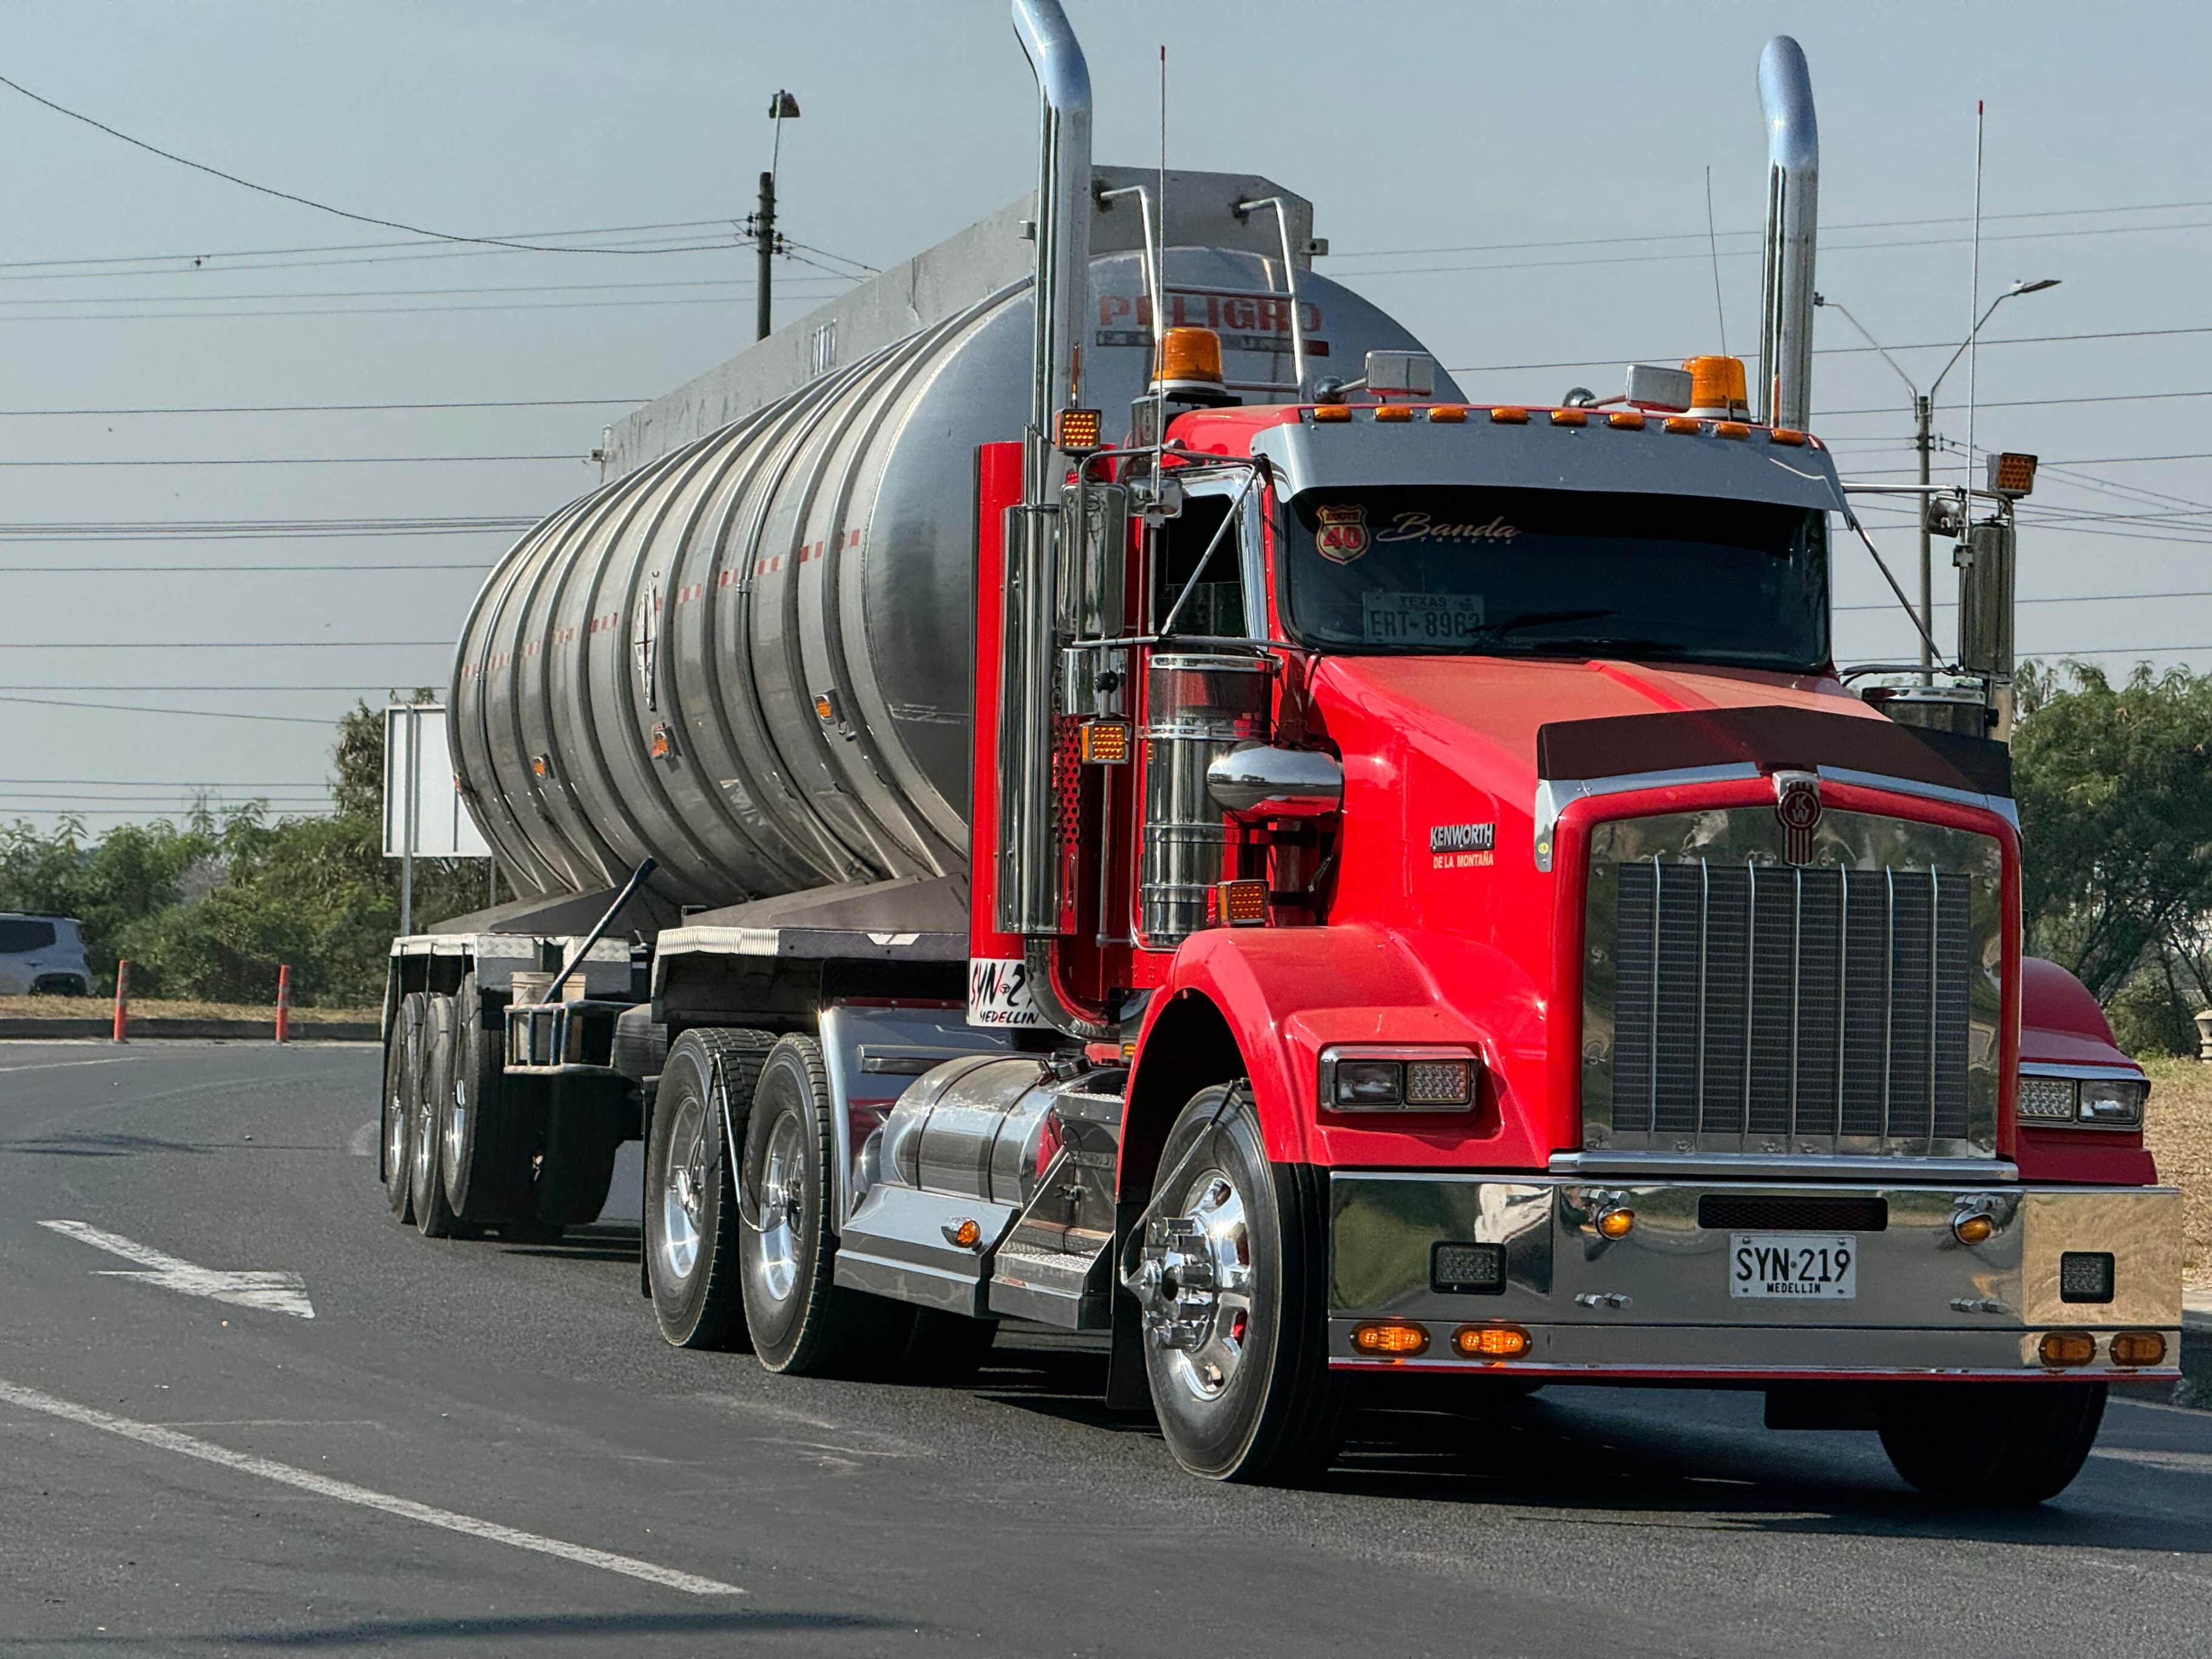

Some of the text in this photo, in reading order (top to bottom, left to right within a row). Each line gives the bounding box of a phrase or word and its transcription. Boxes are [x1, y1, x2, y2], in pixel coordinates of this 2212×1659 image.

[1376, 512, 1520, 541] Banda
[1324, 526, 1362, 550] 40
[1399, 595, 1448, 608] TEXAS
[1430, 823, 1493, 847] KENWORTH
[1433, 850, 1494, 869] DE LA MONTAÑA
[1767, 1282, 1820, 1294] MEDELLIN
